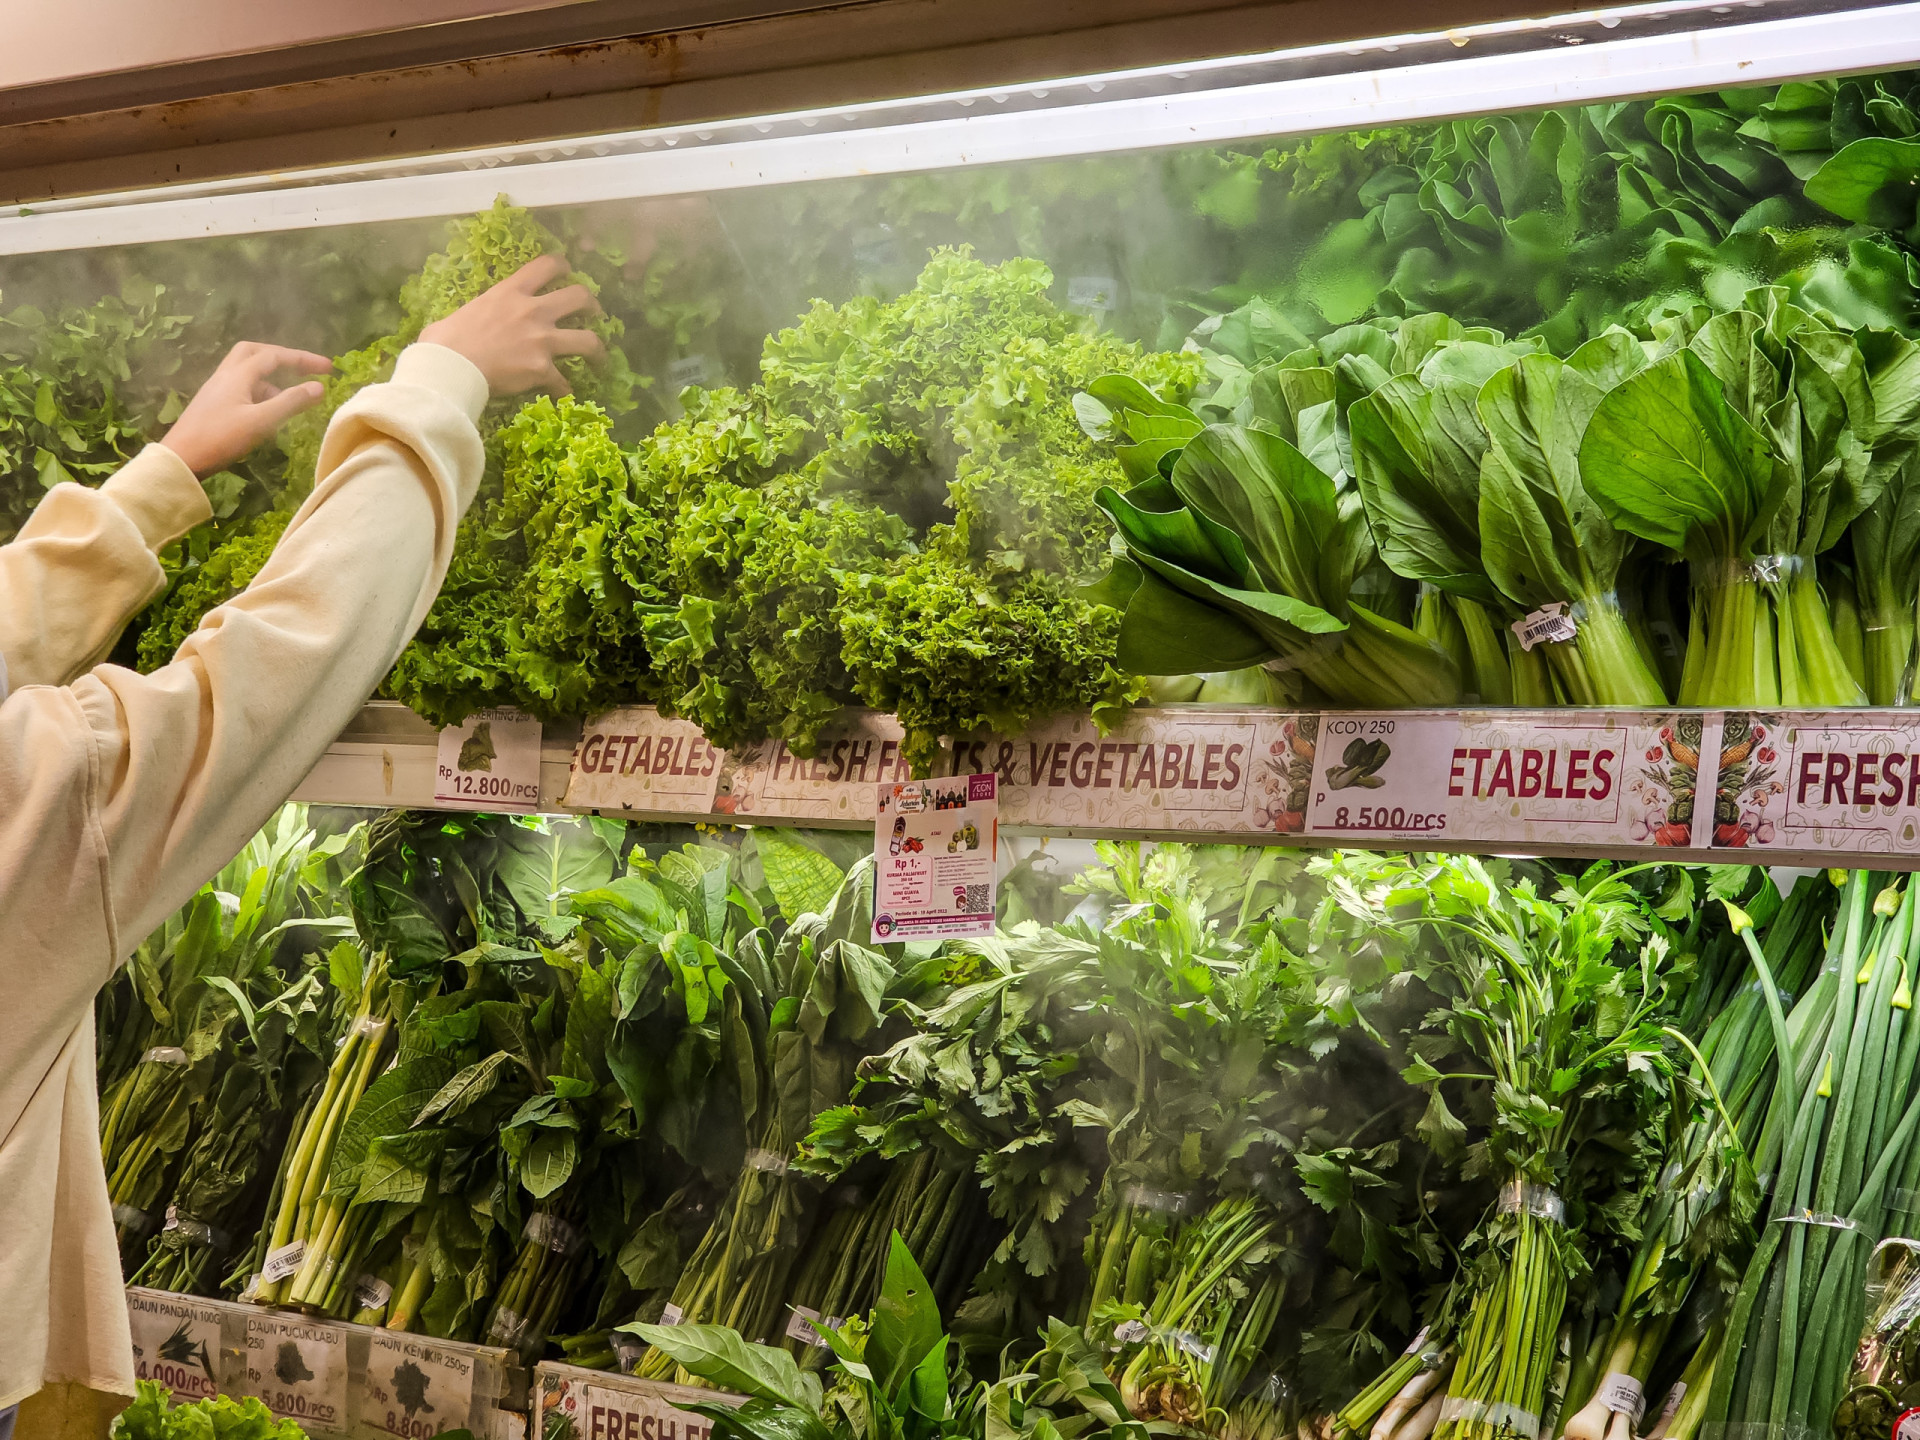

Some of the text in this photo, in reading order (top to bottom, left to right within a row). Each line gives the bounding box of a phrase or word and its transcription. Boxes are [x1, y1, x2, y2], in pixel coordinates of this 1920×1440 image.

[1369, 720, 1395, 734] 250
[439, 764, 453, 780] Rp
[993, 741, 1017, 786] &
[1029, 741, 1244, 791] VEGETABLES
[1448, 748, 1615, 801] ETABLES
[453, 775, 538, 798] 12.800/PCS
[1334, 806, 1446, 830] 8.500/PCS
[895, 858, 921, 871] Rp 1,-
[132, 1299, 220, 1325] DAUN PANDAN 100G
[248, 1320, 339, 1345] DAUN PUCUK LABU
[248, 1337, 265, 1350] 250
[374, 1337, 401, 1352] DAUN
[445, 1355, 471, 1376] 250gr
[248, 1367, 262, 1383] Rp
[374, 1386, 388, 1404] Rp
